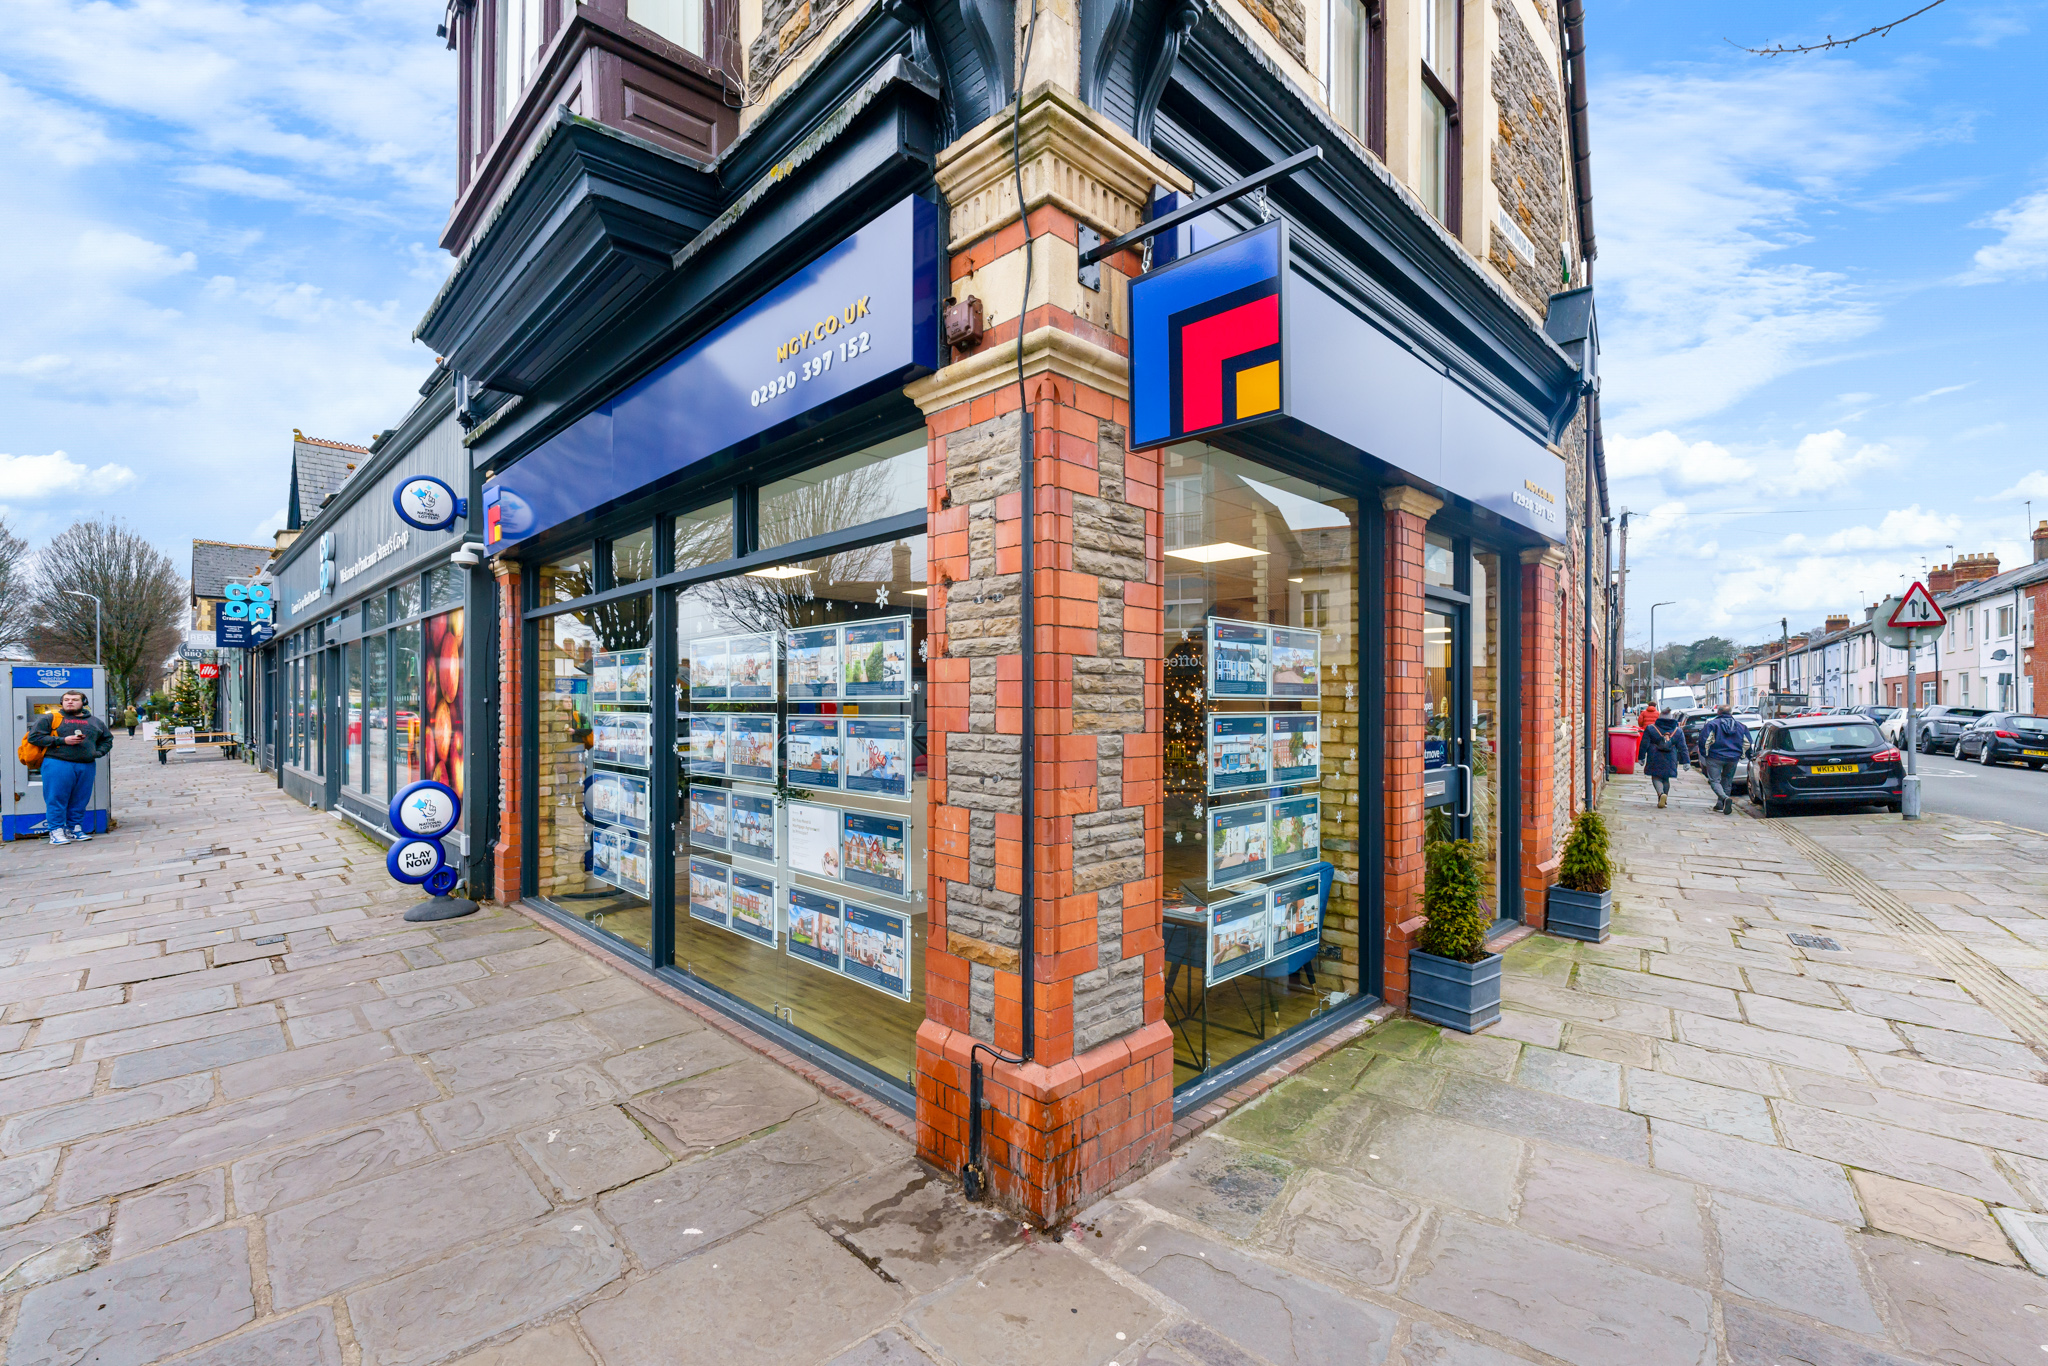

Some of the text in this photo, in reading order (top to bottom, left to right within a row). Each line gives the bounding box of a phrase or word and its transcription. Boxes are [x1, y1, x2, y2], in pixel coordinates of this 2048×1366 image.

[777, 295, 871, 363] MGY.CO.UK
[751, 331, 871, 407] 02920 397 152
[1511, 491, 1533, 510] 02920
[37, 669, 70, 677] cash
[201, 666, 217, 677] illy
[869, 740, 887, 767] SOLD
[405, 850, 431, 860] PLAY
[867, 835, 886, 864] SOLD
[406, 858, 432, 868] NOW
